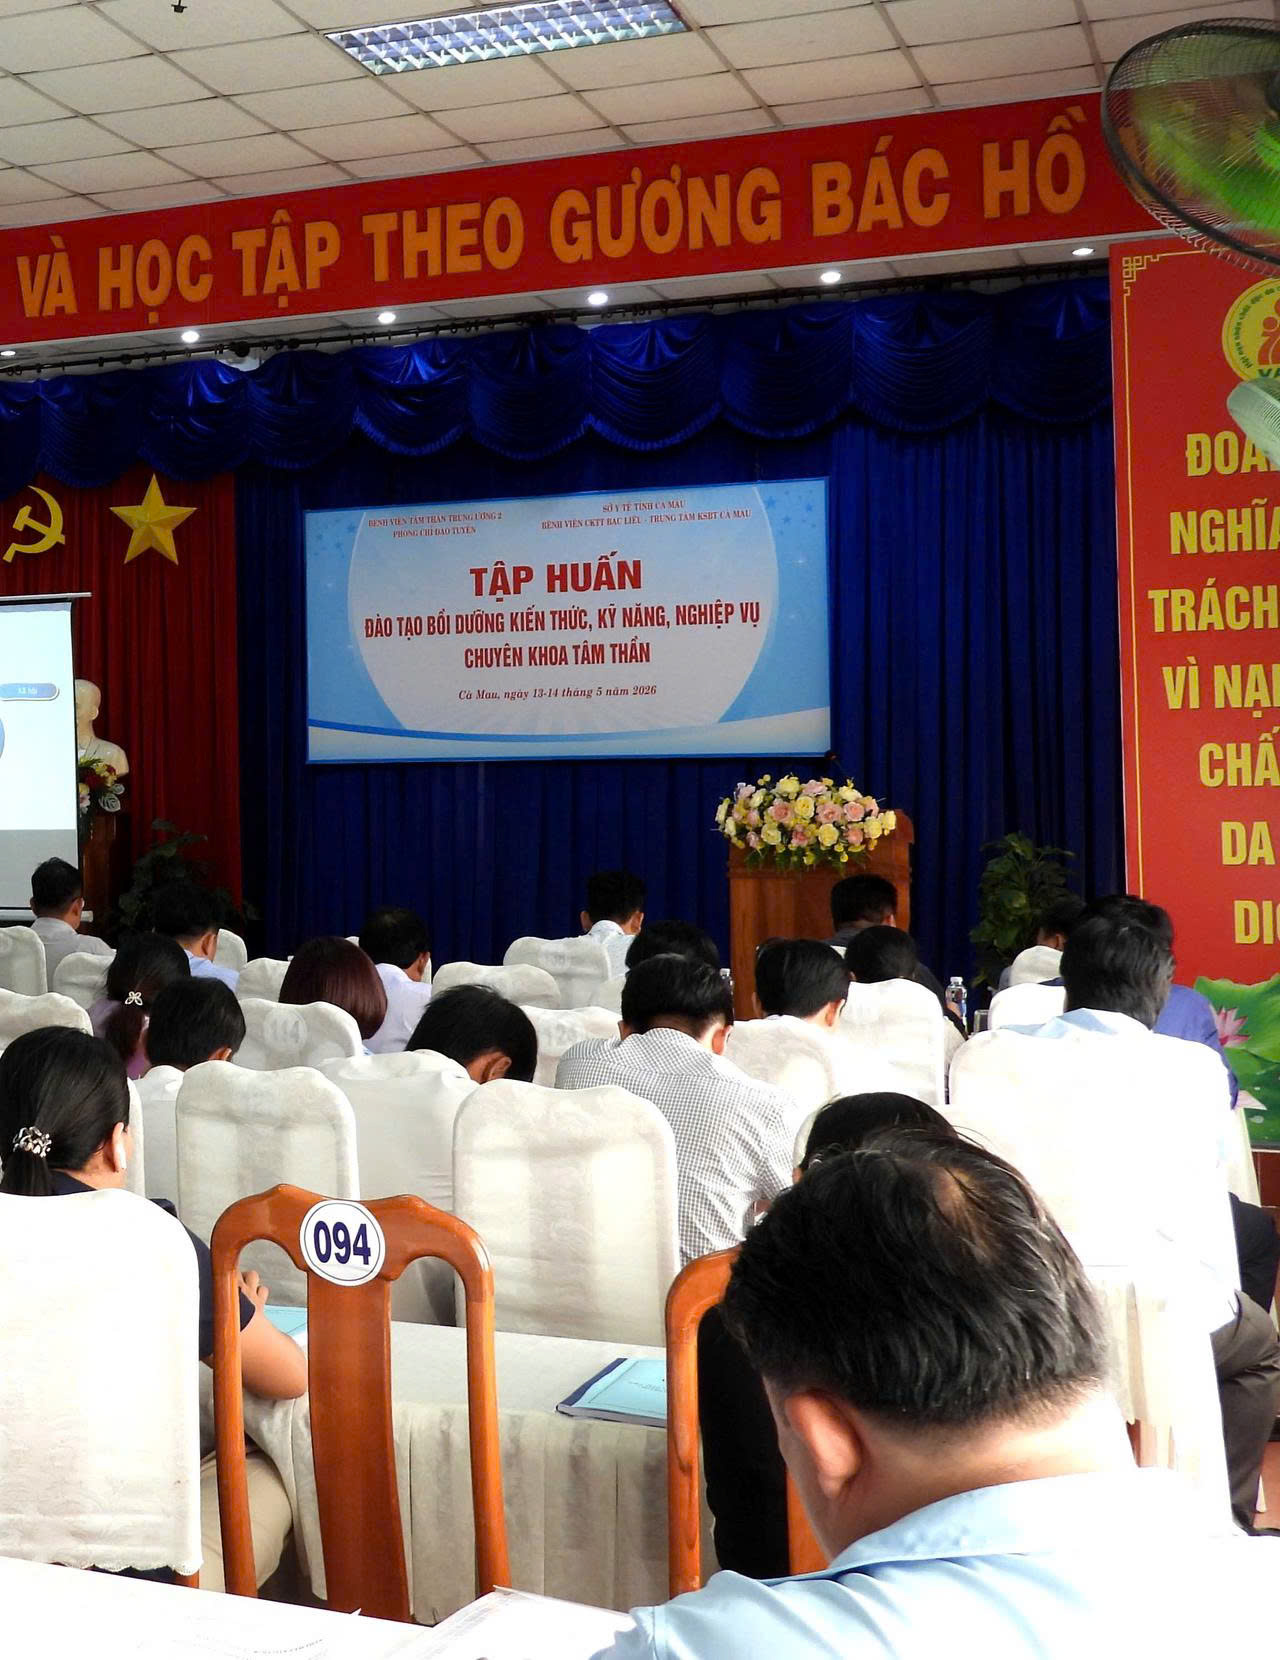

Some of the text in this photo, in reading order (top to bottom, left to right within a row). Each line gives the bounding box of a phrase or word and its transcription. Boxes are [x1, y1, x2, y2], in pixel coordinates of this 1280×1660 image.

[16, 236, 80, 317] VÀ
[98, 233, 214, 324] HỌC
[231, 209, 341, 308] TẬP
[362, 196, 525, 282] THEO
[549, 164, 782, 264] GƯƠNG
[811, 135, 950, 237] BÁC
[981, 106, 1088, 219] HỒ
[1185, 430, 1280, 477] ĐOA
[470, 551, 642, 602] TẬP HUẤN
[365, 599, 760, 640] ĐÀO TẠO BỒI DƯỠNG KIẾN THỨC, KỸ NĂNG, NGHIỆP VỤ
[1147, 577, 1279, 633] TRÁCH
[464, 635, 650, 668] CHUYÊN KHOA TÂM THẦN
[476, 689, 500, 700] Mau,
[504, 688, 529, 701] ngày
[533, 688, 558, 698] 13-14
[561, 687, 593, 699] tháng
[596, 687, 603, 696] 5
[606, 686, 629, 696] năm
[632, 685, 657, 696] 2026
[1162, 656, 1200, 710] VÌ
[1221, 821, 1276, 866] DA
[1234, 900, 1280, 945] DI
[313, 1219, 372, 1266] 094
